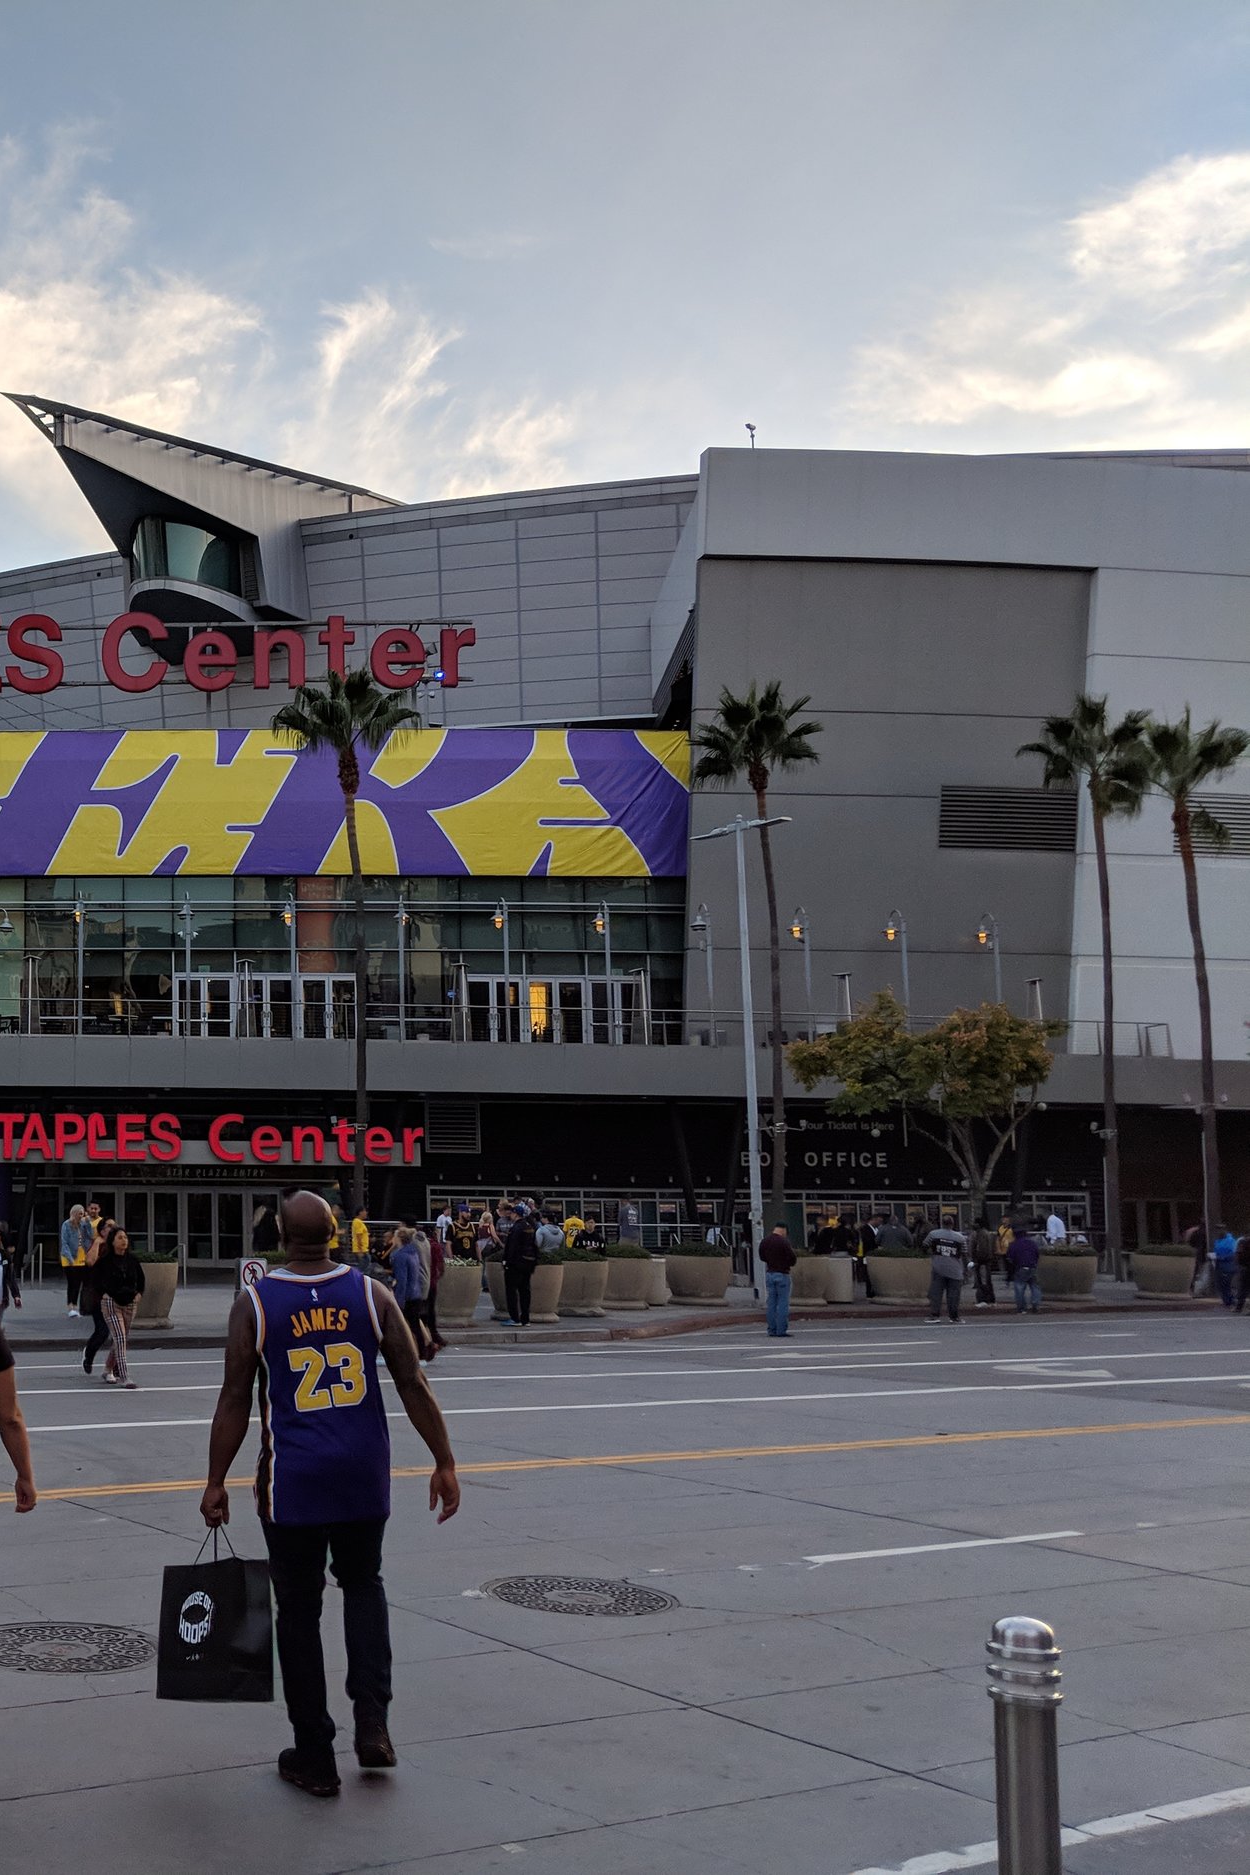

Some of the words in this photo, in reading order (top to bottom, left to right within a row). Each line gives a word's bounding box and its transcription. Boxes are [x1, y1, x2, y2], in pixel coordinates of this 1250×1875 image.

[101, 610, 476, 693] Center
[207, 1112, 425, 1164] Center
[826, 1121, 858, 1131] Ticket
[804, 1151, 889, 1169] OFFICE
[289, 1307, 350, 1338] JAMES
[287, 1341, 368, 1412] 23
